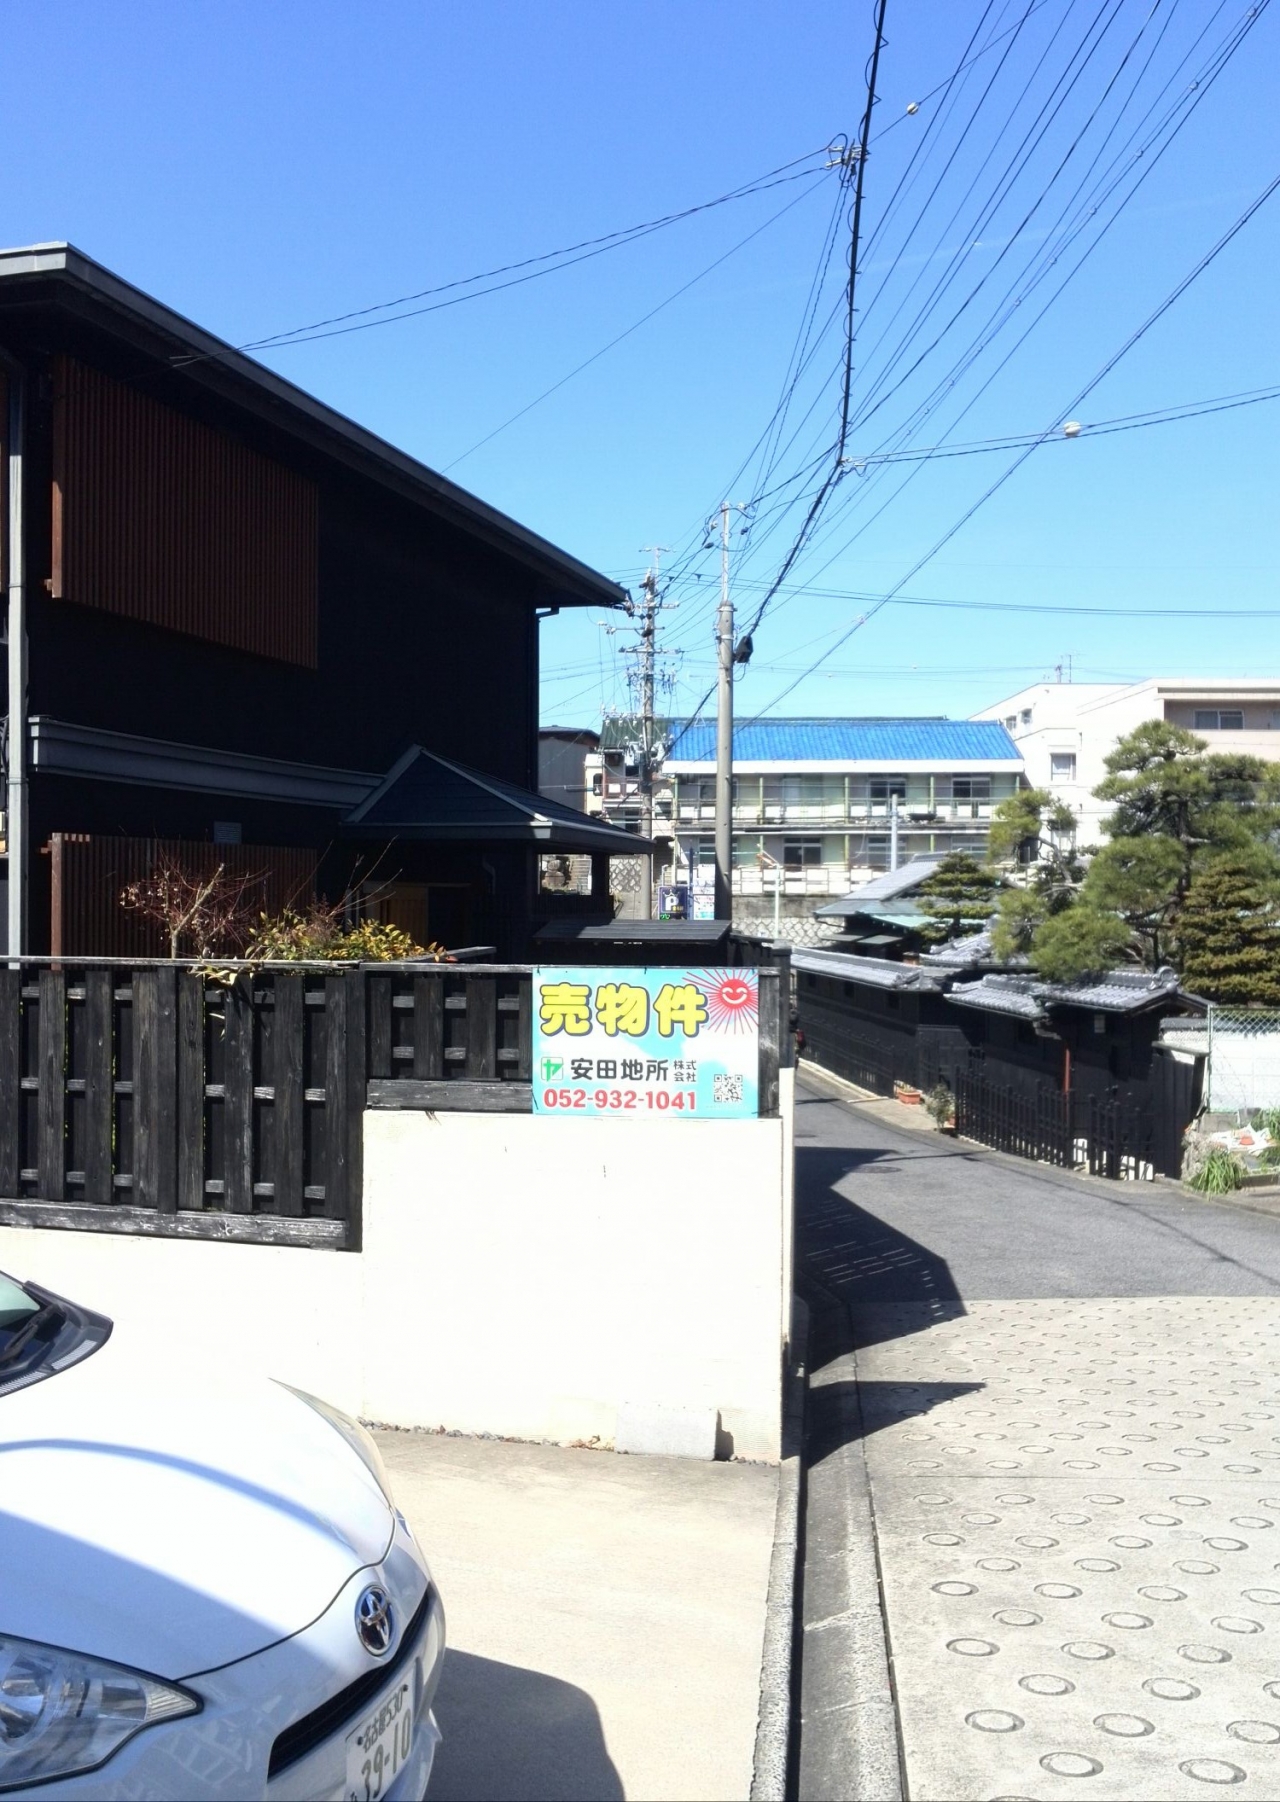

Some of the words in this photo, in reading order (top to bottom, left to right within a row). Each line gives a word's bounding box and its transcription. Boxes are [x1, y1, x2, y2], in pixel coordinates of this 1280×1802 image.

[540, 982, 709, 1037] 売物件
[570, 1057, 669, 1082] 安田地所
[673, 1060, 697, 1070] 株式
[673, 1071, 697, 1082] 会社
[543, 1088, 696, 1110] 052-932-1041
